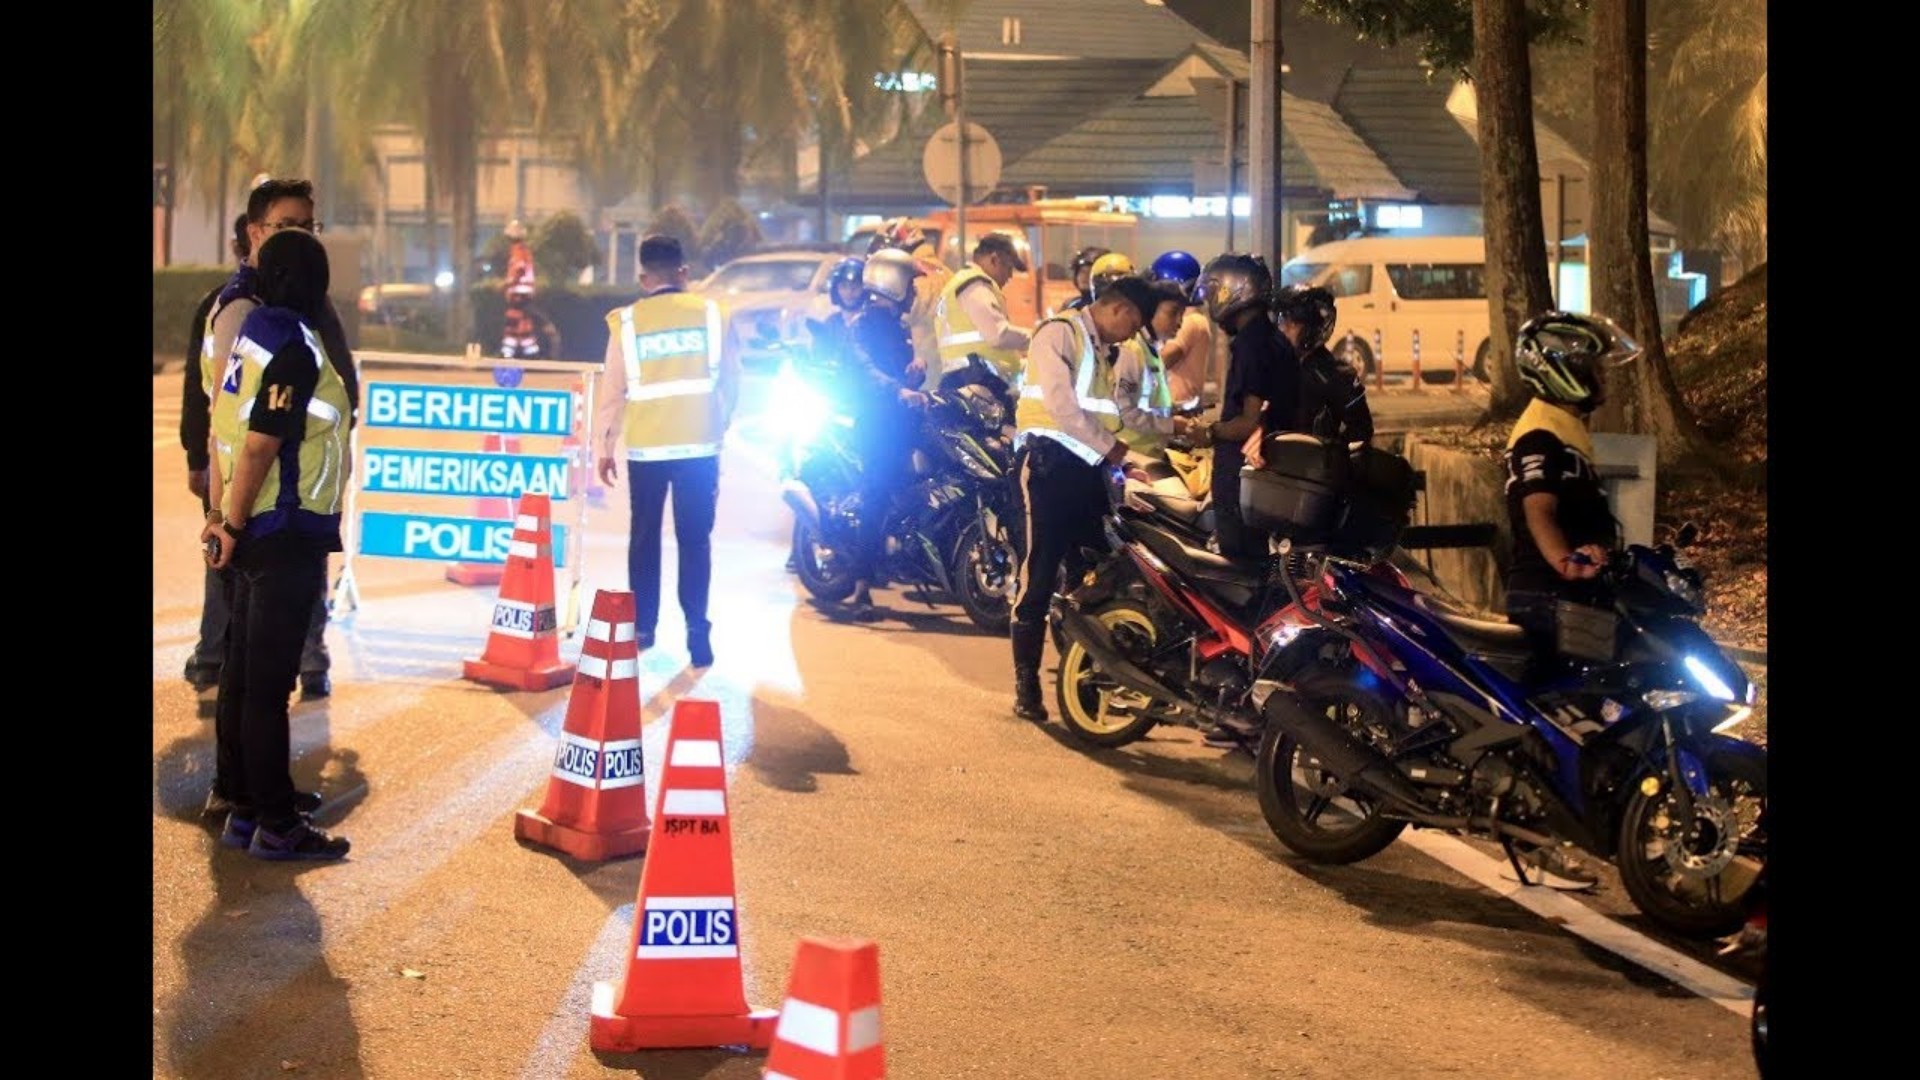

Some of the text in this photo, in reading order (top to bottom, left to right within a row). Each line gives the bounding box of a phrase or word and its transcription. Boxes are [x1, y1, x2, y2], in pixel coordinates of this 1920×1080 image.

[639, 330, 704, 360] POLIS
[268, 384, 294, 411] 14
[369, 387, 568, 432] BERHENTI
[363, 452, 568, 497] PEMERIKSAAN
[494, 605, 533, 631] POLIS
[557, 741, 597, 777] POLIS
[604, 748, 641, 778] POLIS
[647, 909, 731, 945] POLIS
